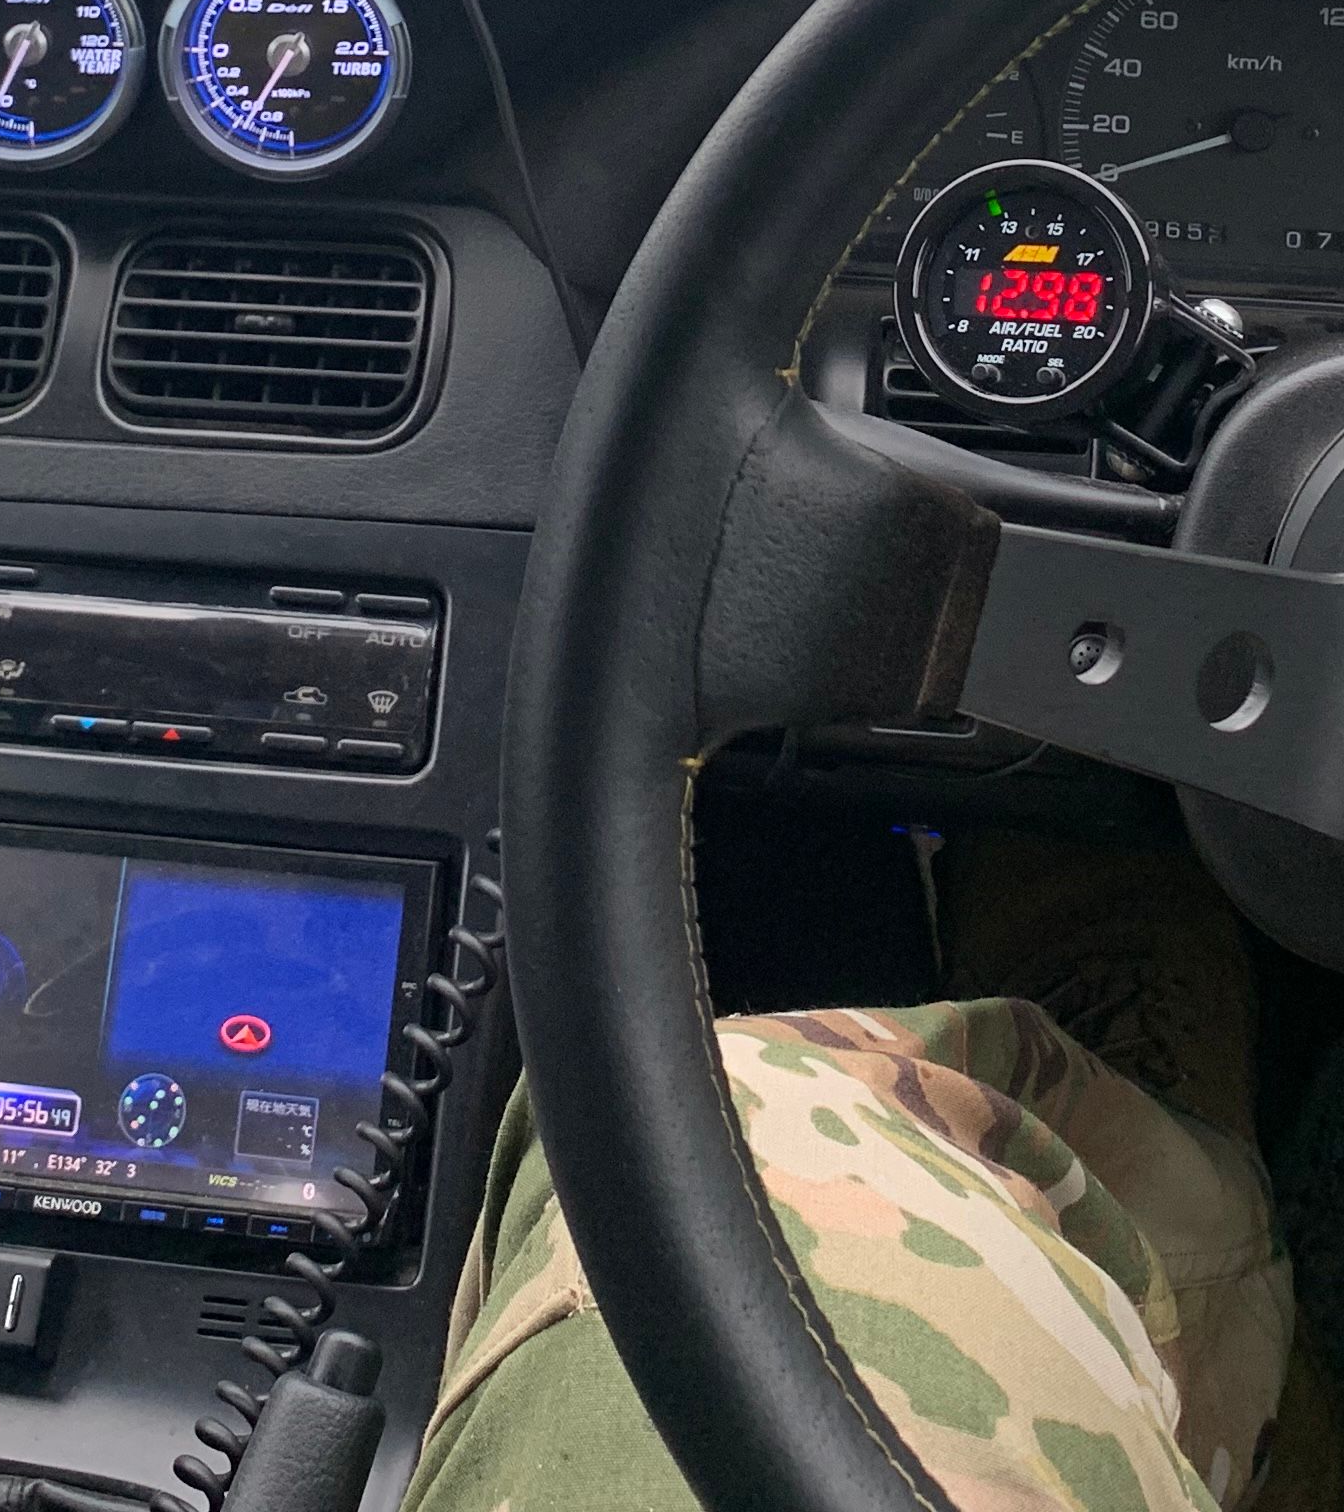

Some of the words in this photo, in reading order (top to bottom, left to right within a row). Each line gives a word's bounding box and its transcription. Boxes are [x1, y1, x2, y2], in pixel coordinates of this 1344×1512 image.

[76, 6, 101, 18] 110
[267, 2, 313, 13] Defi
[322, 0, 348, 13] 1.5
[1141, 11, 1178, 30] 60
[80, 35, 109, 47] 120
[71, 48, 121, 62] WATER
[212, 43, 229, 57] 0
[335, 42, 369, 55] 2.0
[78, 61, 120, 75] TEMP
[332, 61, 382, 76] TURBO
[1104, 59, 1142, 77] 40
[1227, 54, 1282, 72] km/h
[217, 67, 241, 77] 0.2
[226, 85, 248, 96] 0.4
[1093, 115, 1130, 134] 20
[1011, 130, 1024, 144] E
[1000, 221, 1018, 234] 13
[1046, 222, 1064, 235] 15
[964, 248, 981, 261] 11
[1076, 253, 1094, 265] 17
[976, 269, 1103, 322] 12.98
[957, 320, 969, 332] 8
[989, 321, 1062, 338] AIR/FUEL
[1073, 326, 1096, 339] 20
[1001, 339, 1048, 354] RATIO
[976, 354, 1005, 364] MODE
[1047, 358, 1064, 367] SEL
[288, 624, 330, 640] OFF
[365, 631, 426, 649] AUTO
[50, 1107, 72, 1128] 49
[208, 1172, 238, 1188] VICS
[32, 1193, 103, 1217] KENWOOD
